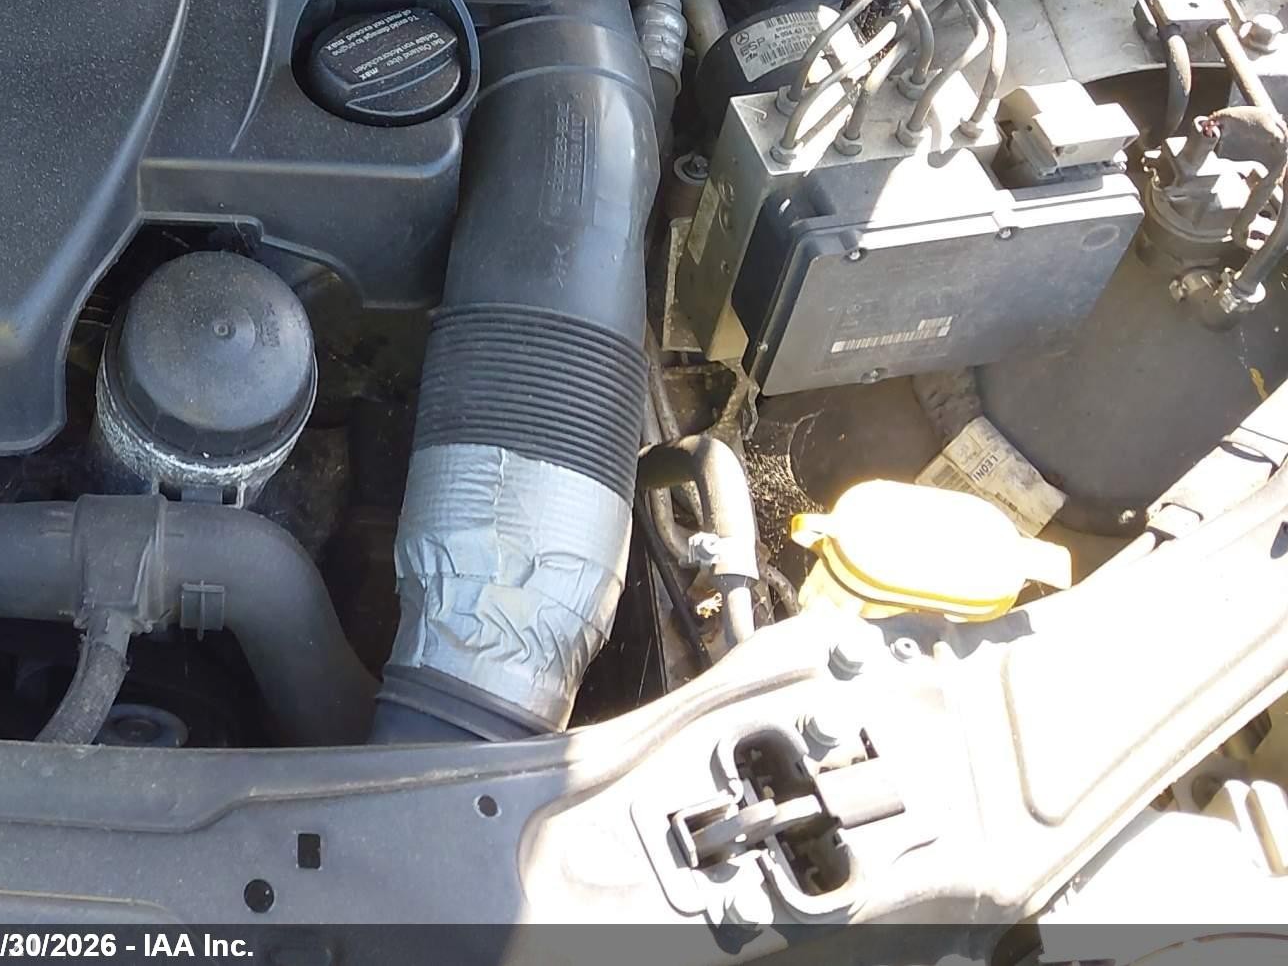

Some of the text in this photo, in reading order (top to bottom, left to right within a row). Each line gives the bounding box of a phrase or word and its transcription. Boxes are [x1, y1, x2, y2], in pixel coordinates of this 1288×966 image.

[324, 38, 346, 51] max
[740, 37, 765, 57] ESP
[358, 67, 379, 81] max
[972, 454, 999, 482] LEONI
